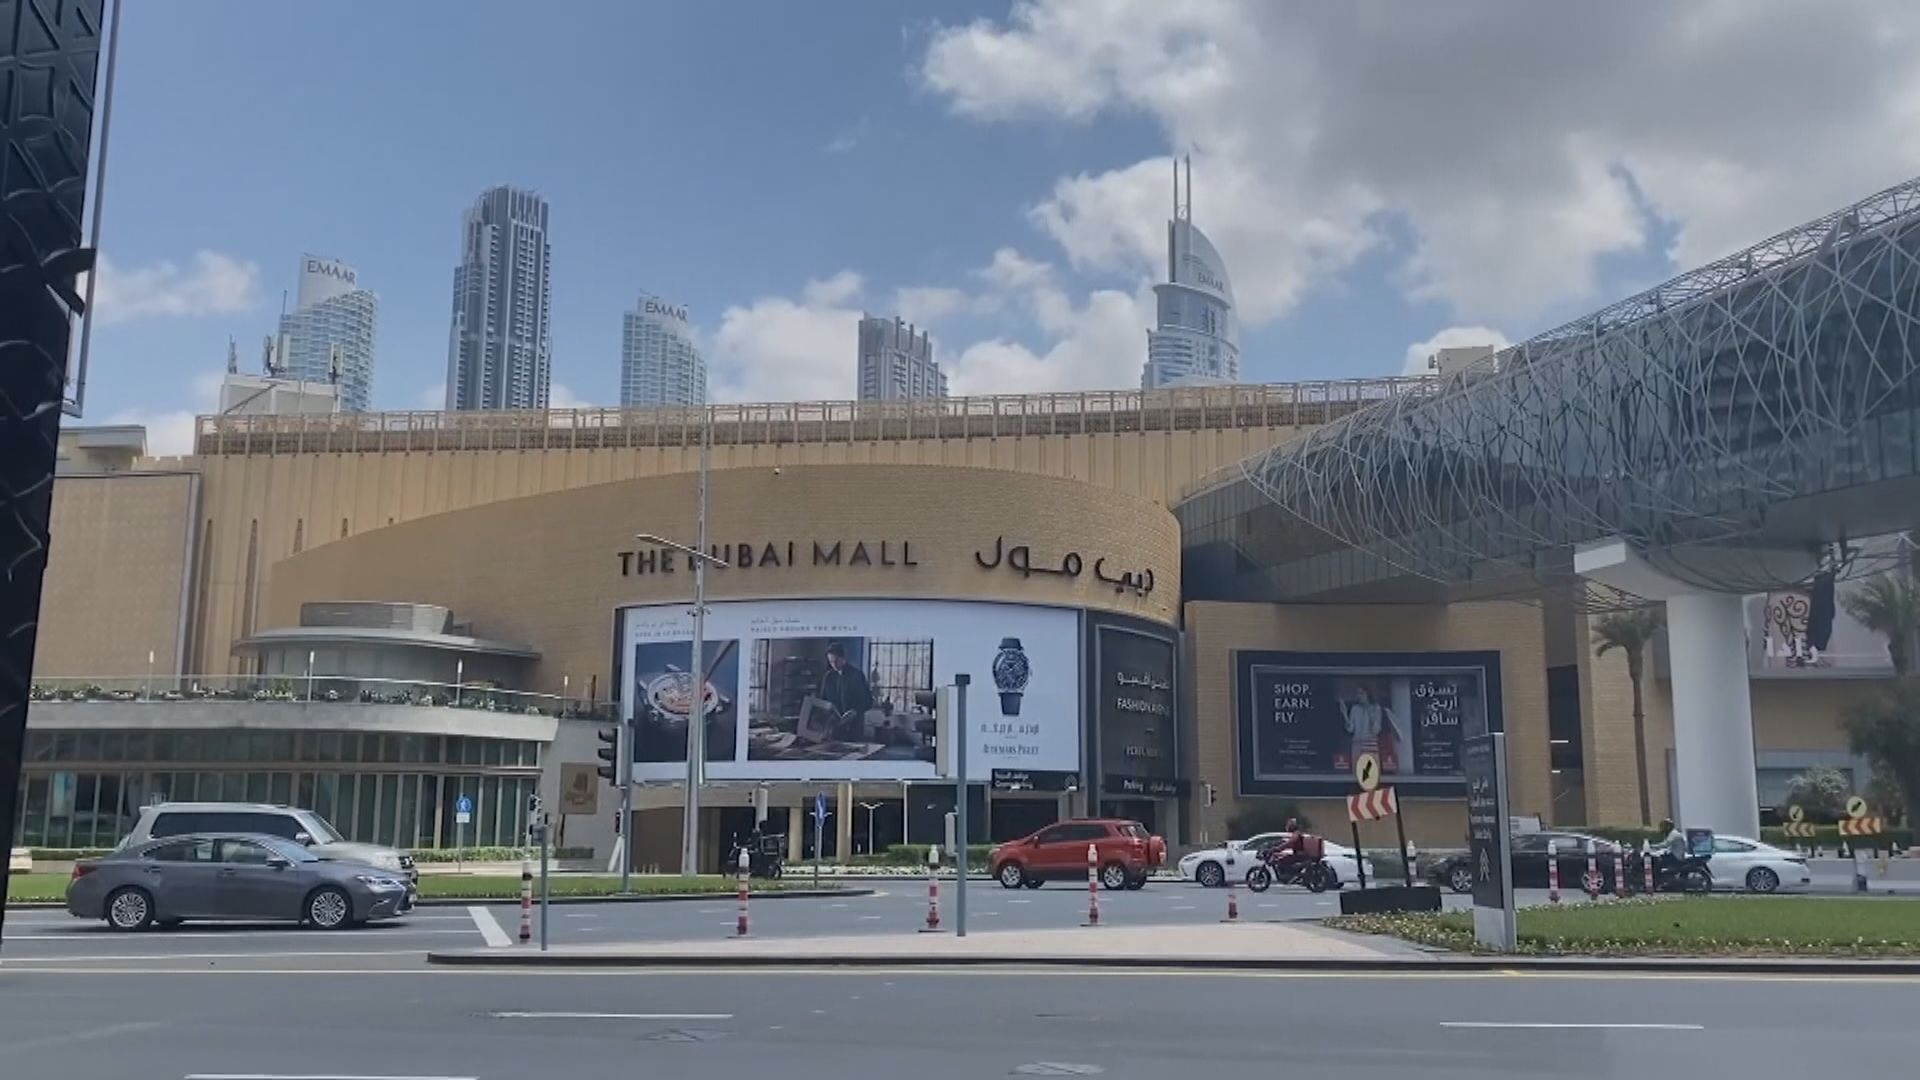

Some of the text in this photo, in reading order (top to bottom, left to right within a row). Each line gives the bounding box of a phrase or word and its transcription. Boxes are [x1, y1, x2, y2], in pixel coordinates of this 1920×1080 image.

[307, 260, 356, 285] EMAAR
[645, 301, 688, 322] EMAAR
[617, 551, 674, 577] THE
[812, 540, 918, 566] MALL
[975, 535, 1154, 597] دبي مول
[1274, 683, 1313, 696] SHOP.
[1274, 697, 1315, 710] EARN.
[1274, 711, 1298, 724] FLY.
